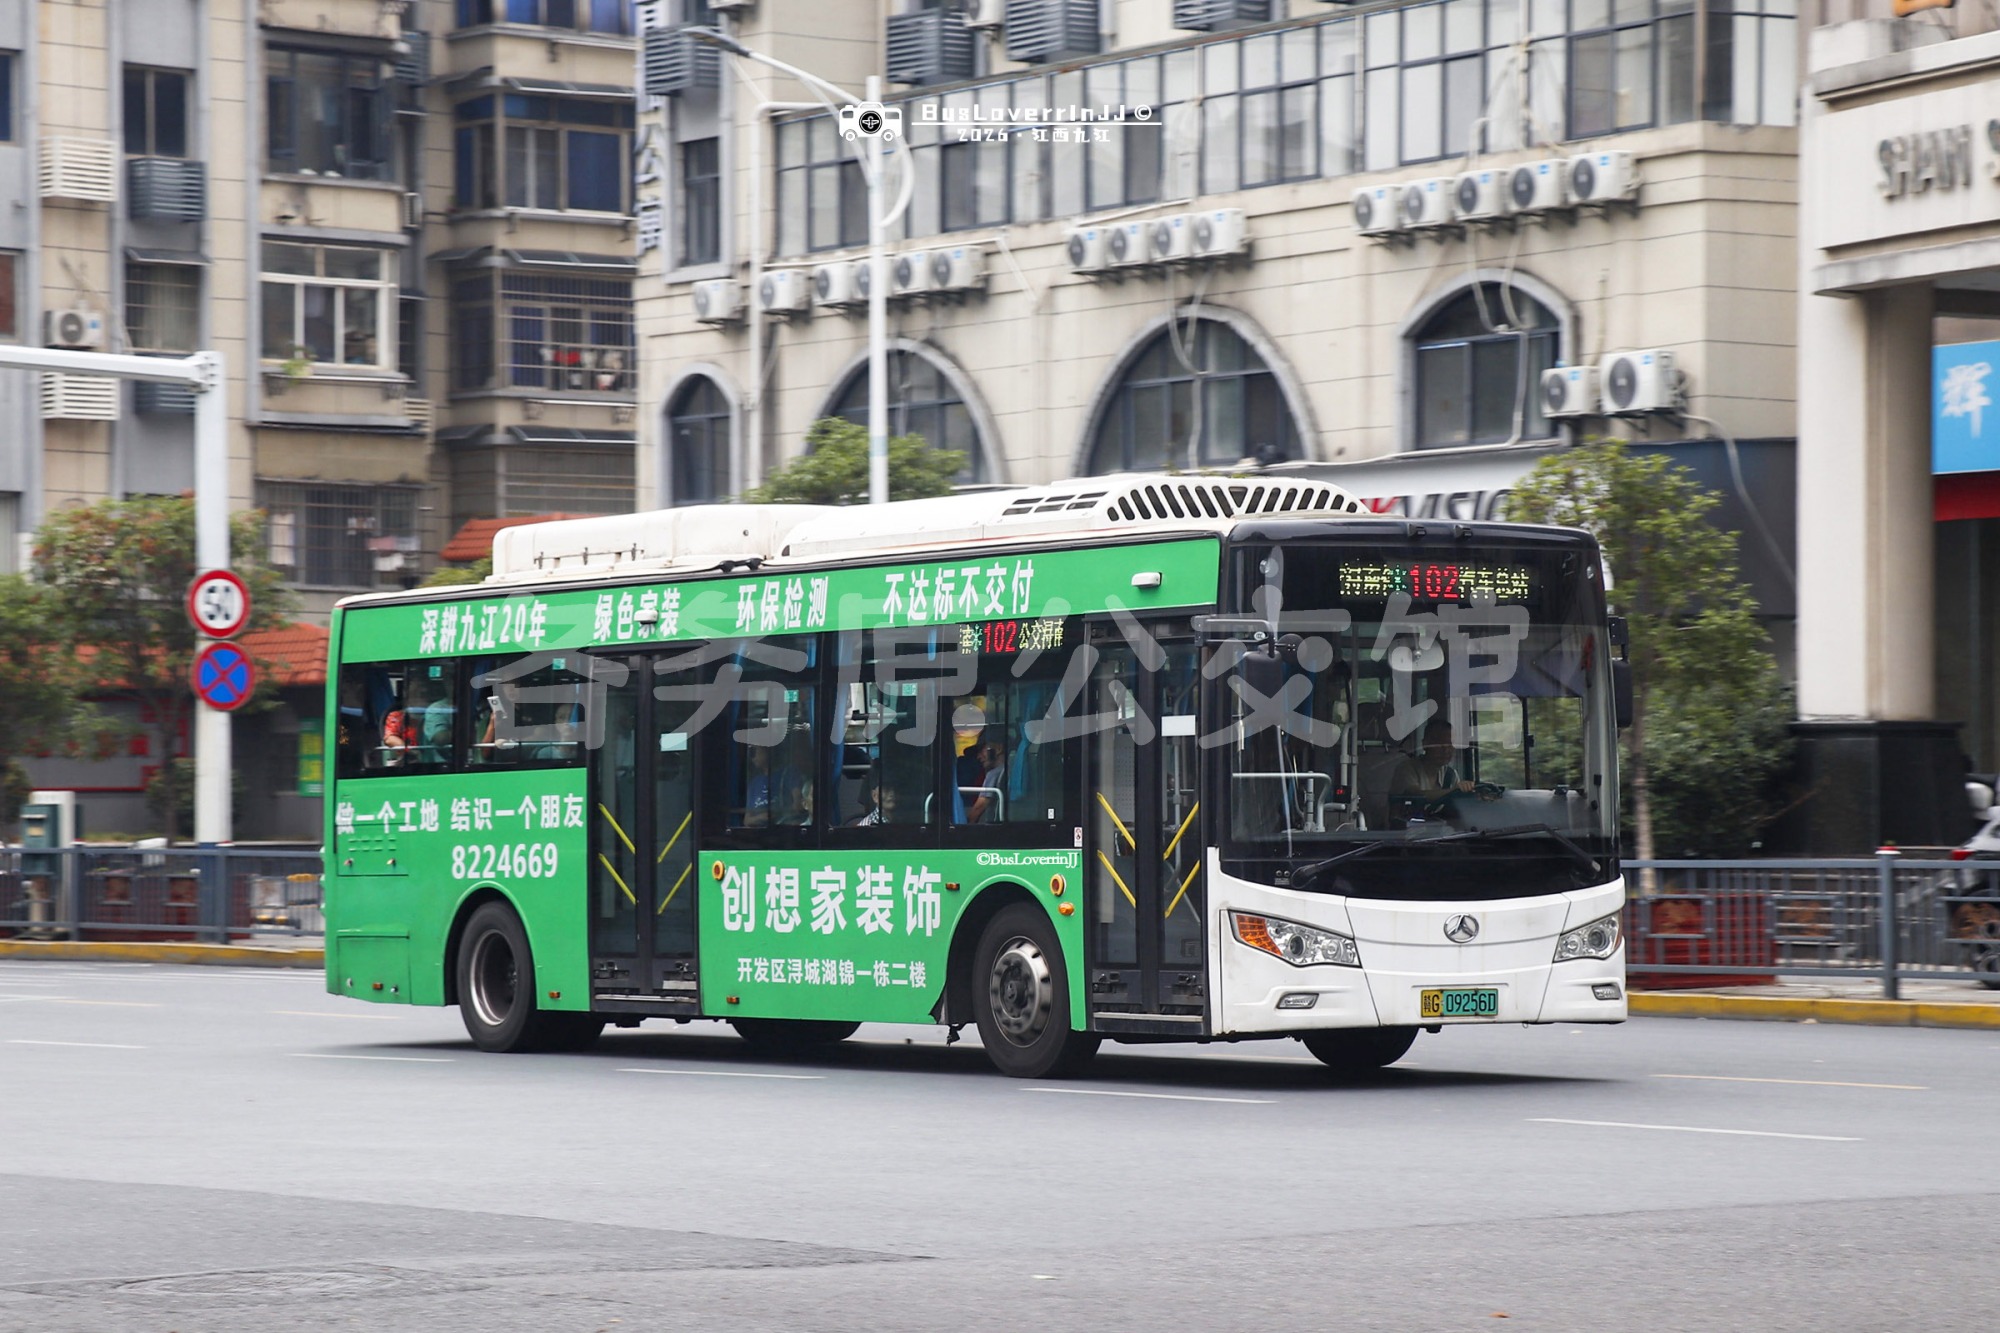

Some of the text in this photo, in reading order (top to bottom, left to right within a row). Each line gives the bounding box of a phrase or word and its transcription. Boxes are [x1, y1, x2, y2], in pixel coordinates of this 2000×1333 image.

[1409, 565, 1460, 599] 102
[418, 599, 548, 655] 深耕九江20年
[734, 575, 830, 633] 环保检测
[882, 558, 1035, 625] 不达标不交付
[983, 620, 1018, 653] 102
[450, 792, 584, 833] 结识一个朋友
[451, 842, 559, 880] 8224669
[720, 864, 942, 938] 创想家装饰
[736, 957, 927, 989] 开发区浔城湖锦一栋二楼
[1445, 993, 1497, 1013] 09256D
